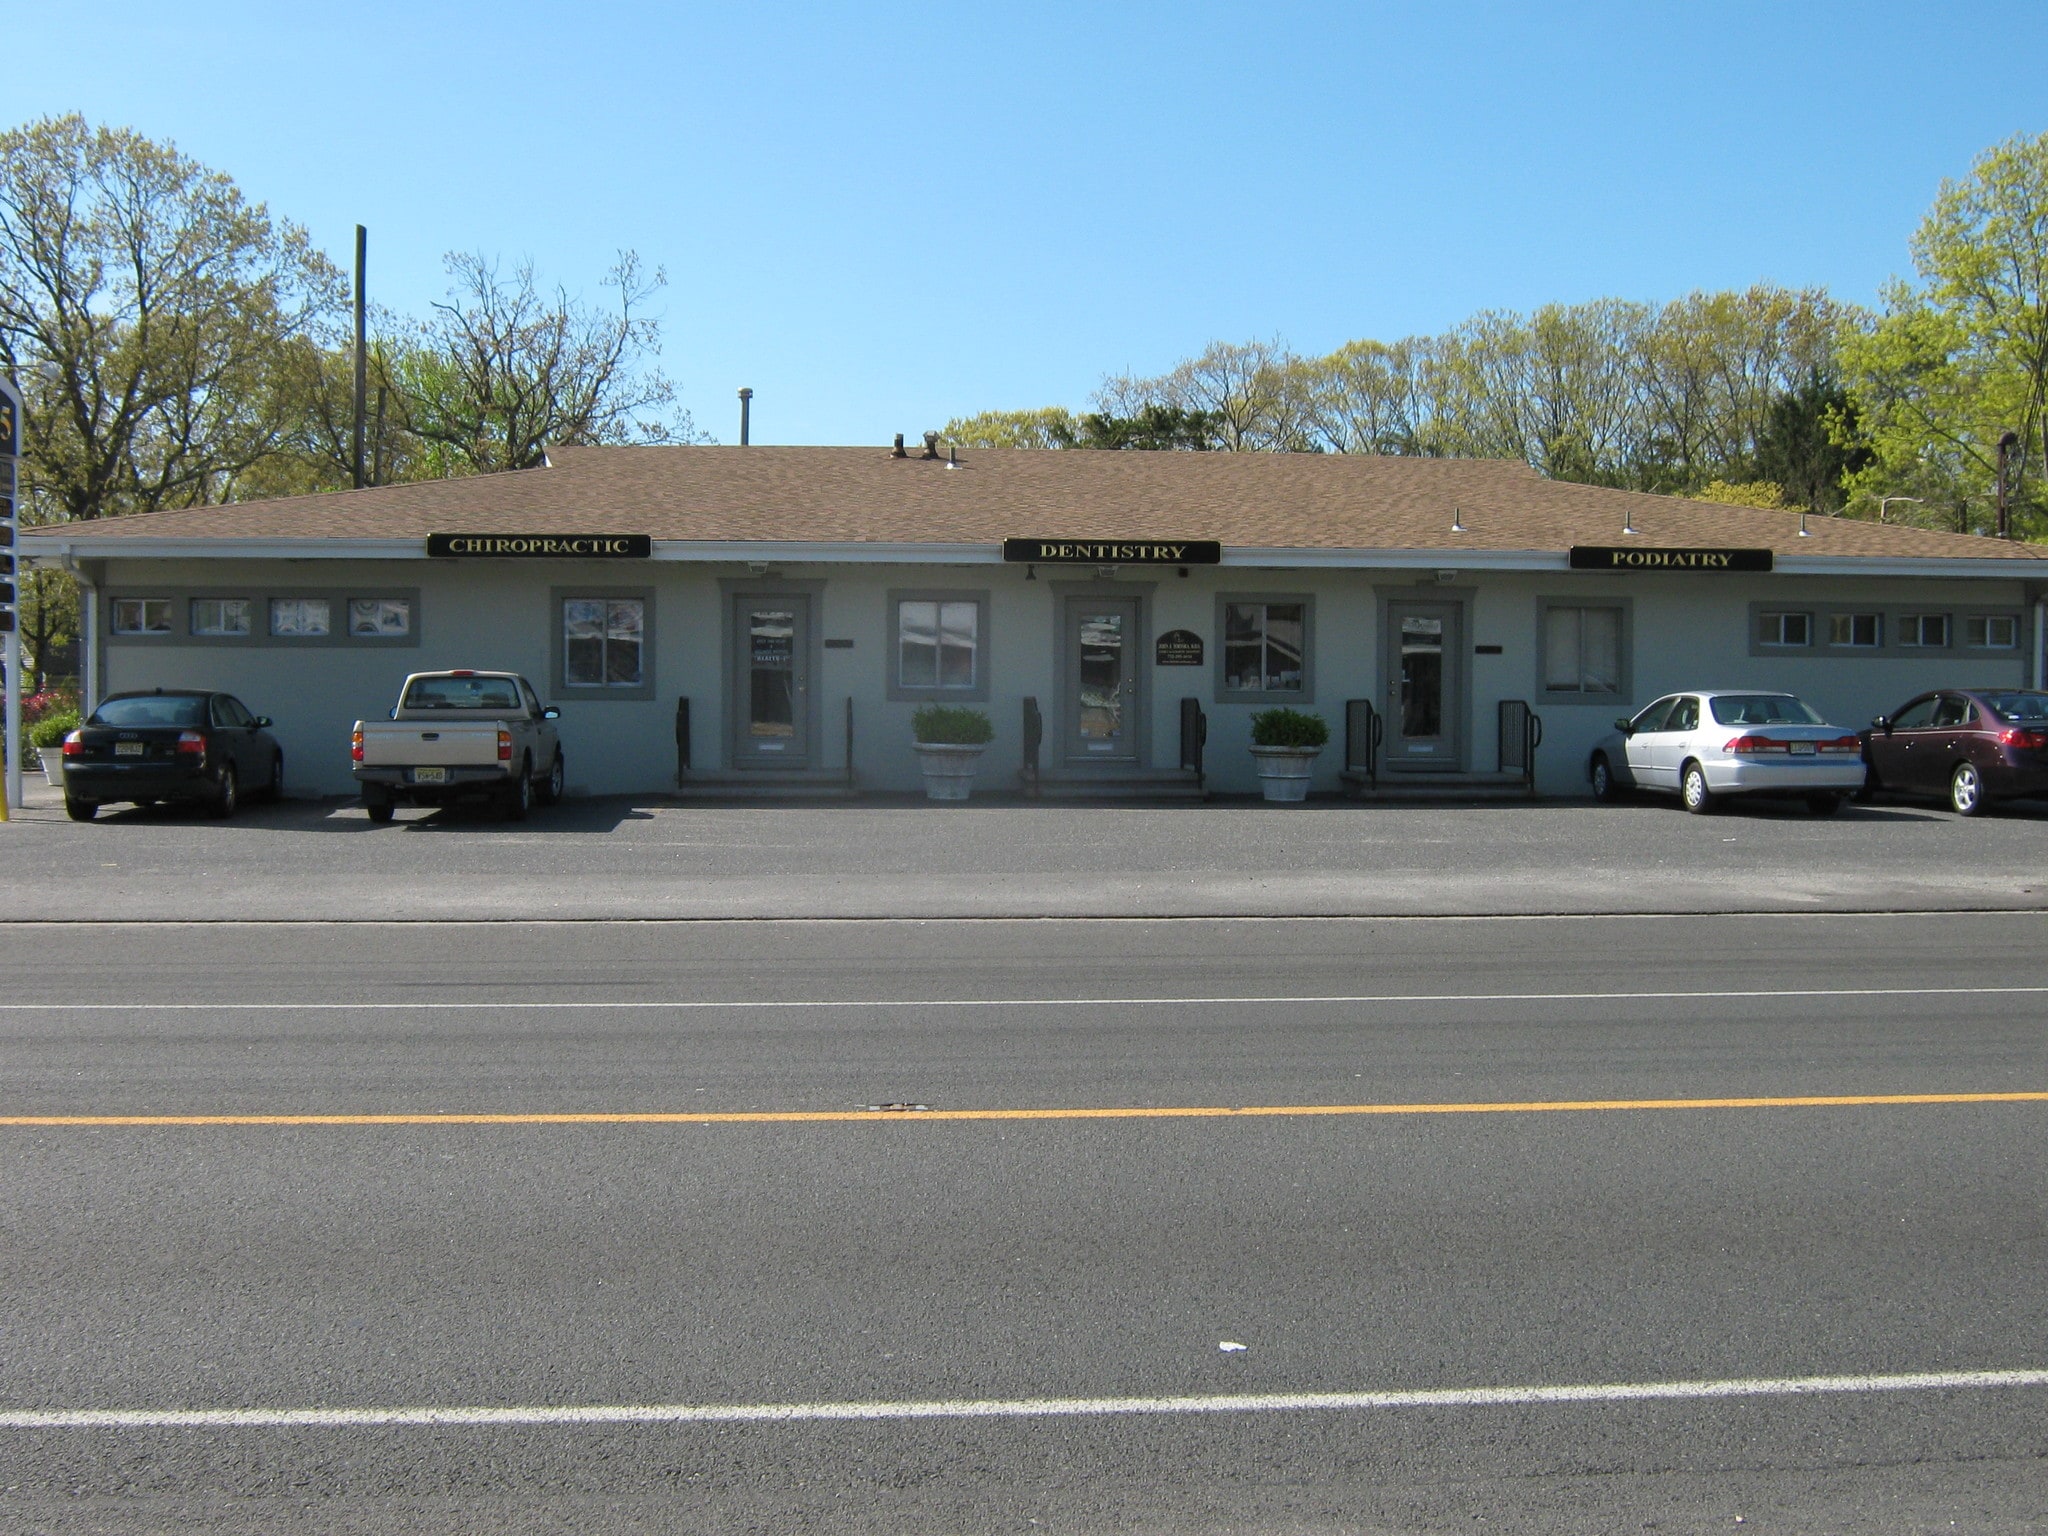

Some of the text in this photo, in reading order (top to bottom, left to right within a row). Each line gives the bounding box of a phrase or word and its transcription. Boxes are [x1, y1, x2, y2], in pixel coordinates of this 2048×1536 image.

[449, 538, 629, 553] CHIROPRACTIC
[1039, 544, 1187, 559] DENTISTRY
[1611, 551, 1734, 567] PODIATRY
